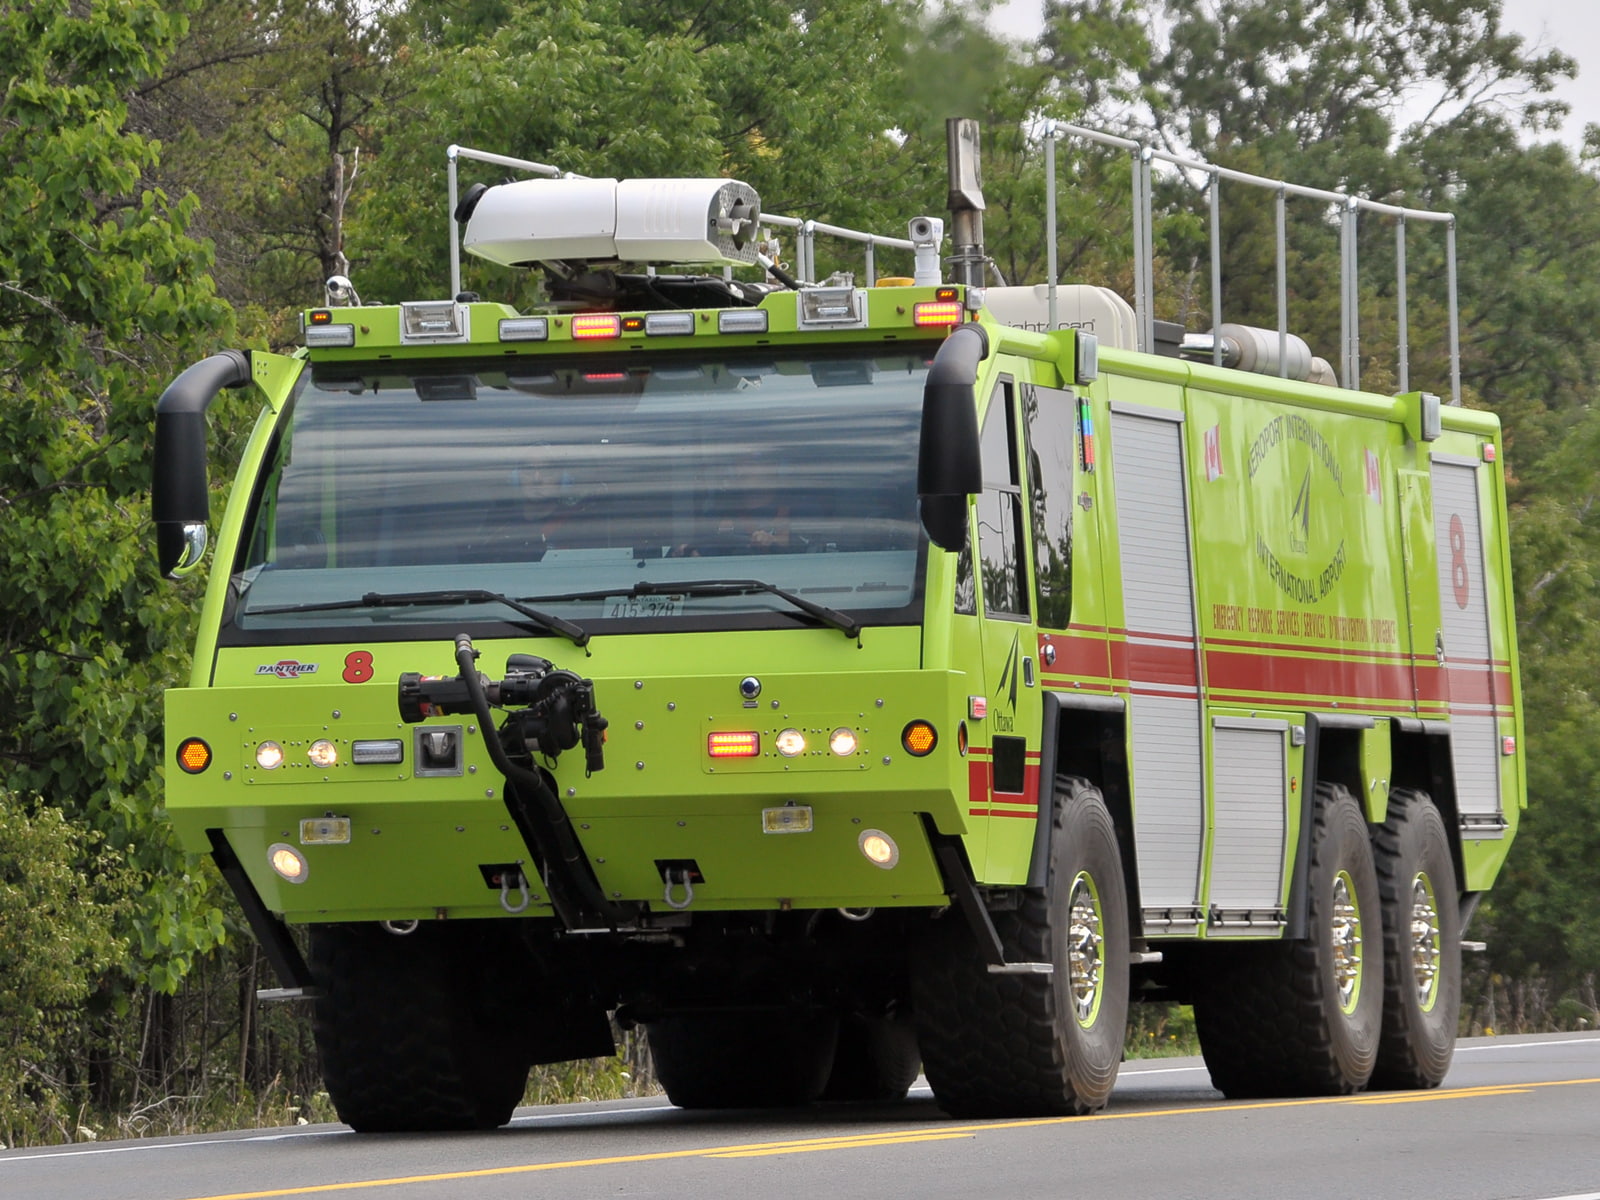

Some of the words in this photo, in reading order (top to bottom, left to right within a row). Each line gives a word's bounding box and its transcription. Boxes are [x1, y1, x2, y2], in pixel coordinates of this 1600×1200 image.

[1286, 414, 1345, 496] INTERNATIONAL
[1256, 532, 1318, 604] INTERNATIONAL
[1320, 539, 1347, 600] AIRPORT
[1449, 513, 1469, 610] 8
[611, 603, 639, 618] 415
[1213, 603, 1244, 632] EMERGENCY
[1248, 607, 1274, 635] RESPONSE
[1276, 610, 1300, 637] SERVICES
[1303, 612, 1326, 639] SERVICES
[258, 663, 315, 673] PANTHER
[342, 650, 374, 684] 8
[993, 708, 1014, 732] Ottawa
